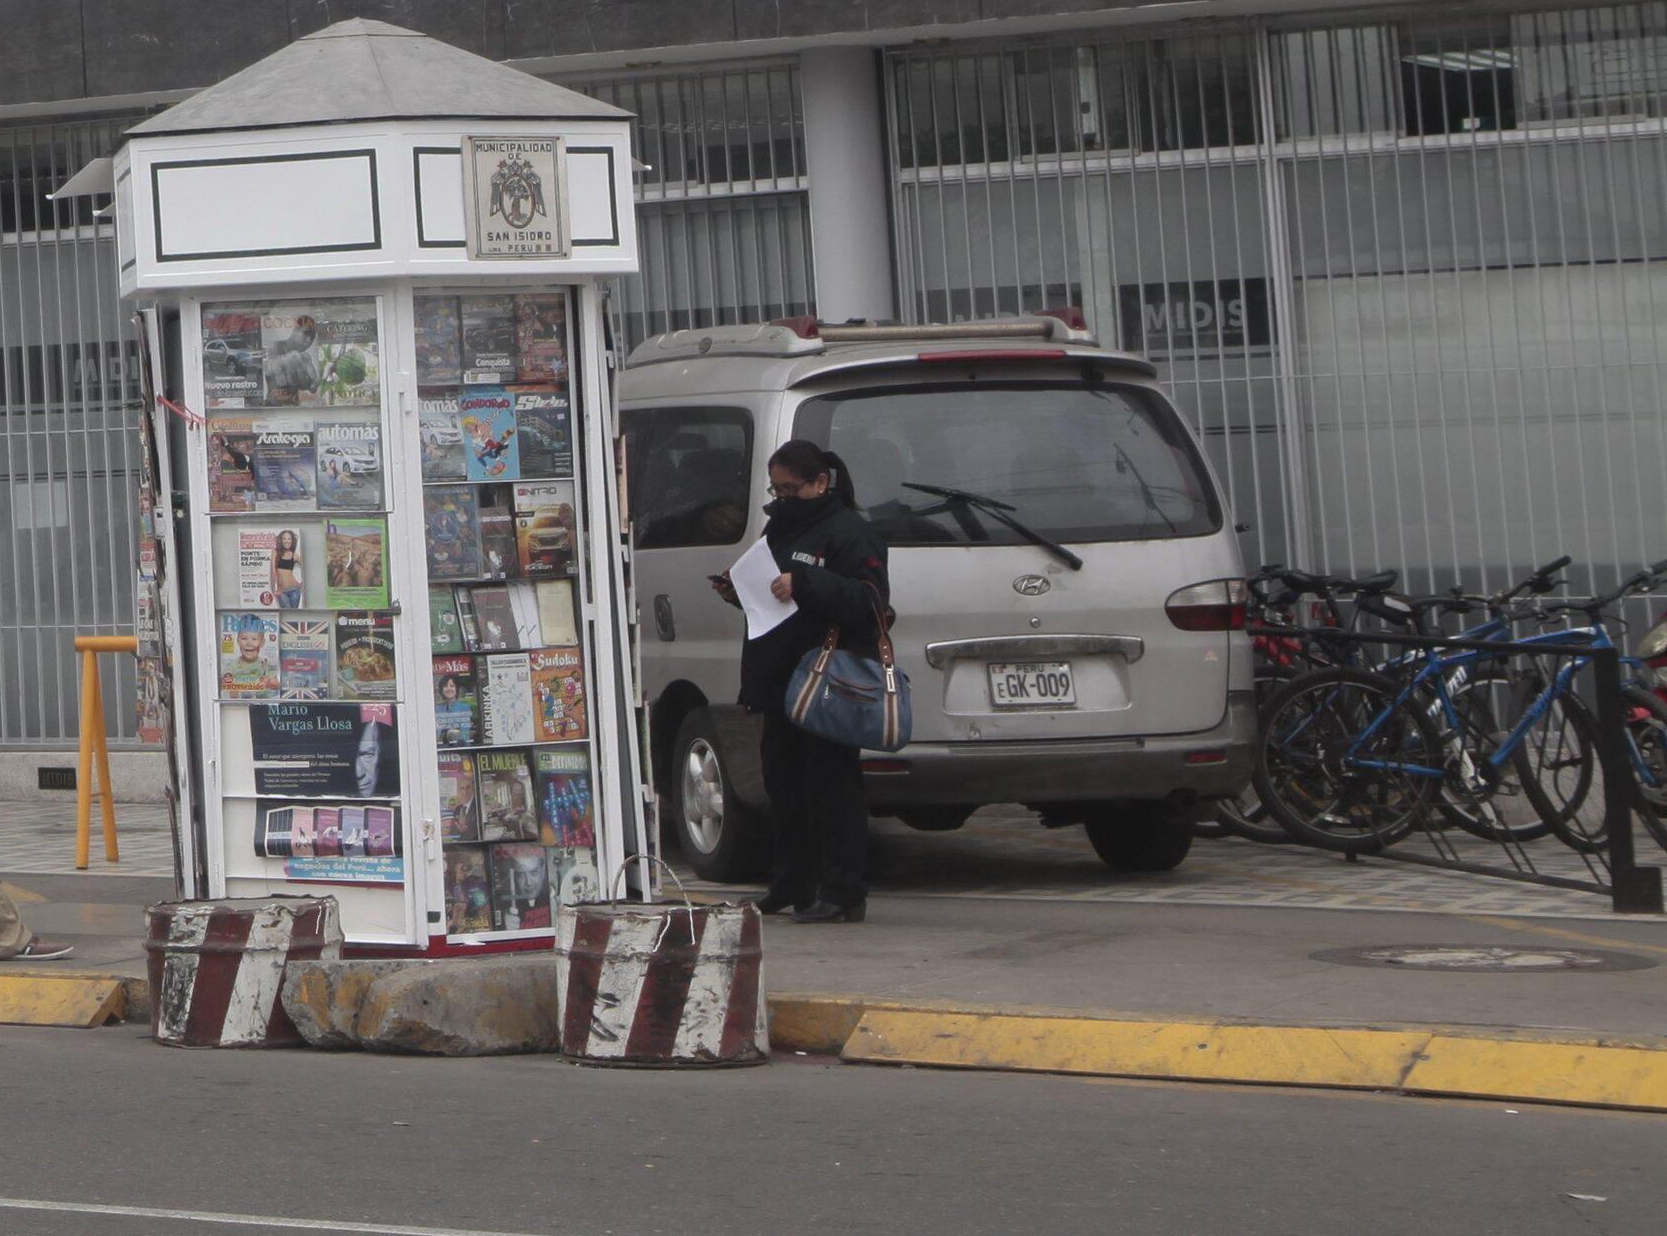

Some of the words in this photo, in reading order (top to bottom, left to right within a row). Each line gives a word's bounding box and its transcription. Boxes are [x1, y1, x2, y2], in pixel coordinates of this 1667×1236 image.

[475, 143, 552, 153] MUNICIPALIDAD
[508, 152, 522, 160] DE
[487, 232, 510, 242] SAN
[515, 231, 552, 241] ISIDRO
[1145, 298, 1245, 331] MIDIS
[1016, 663, 1045, 673] PERU
[267, 703, 308, 716] Mario
[268, 716, 314, 735] Vargas
[317, 715, 353, 731] Llosa
